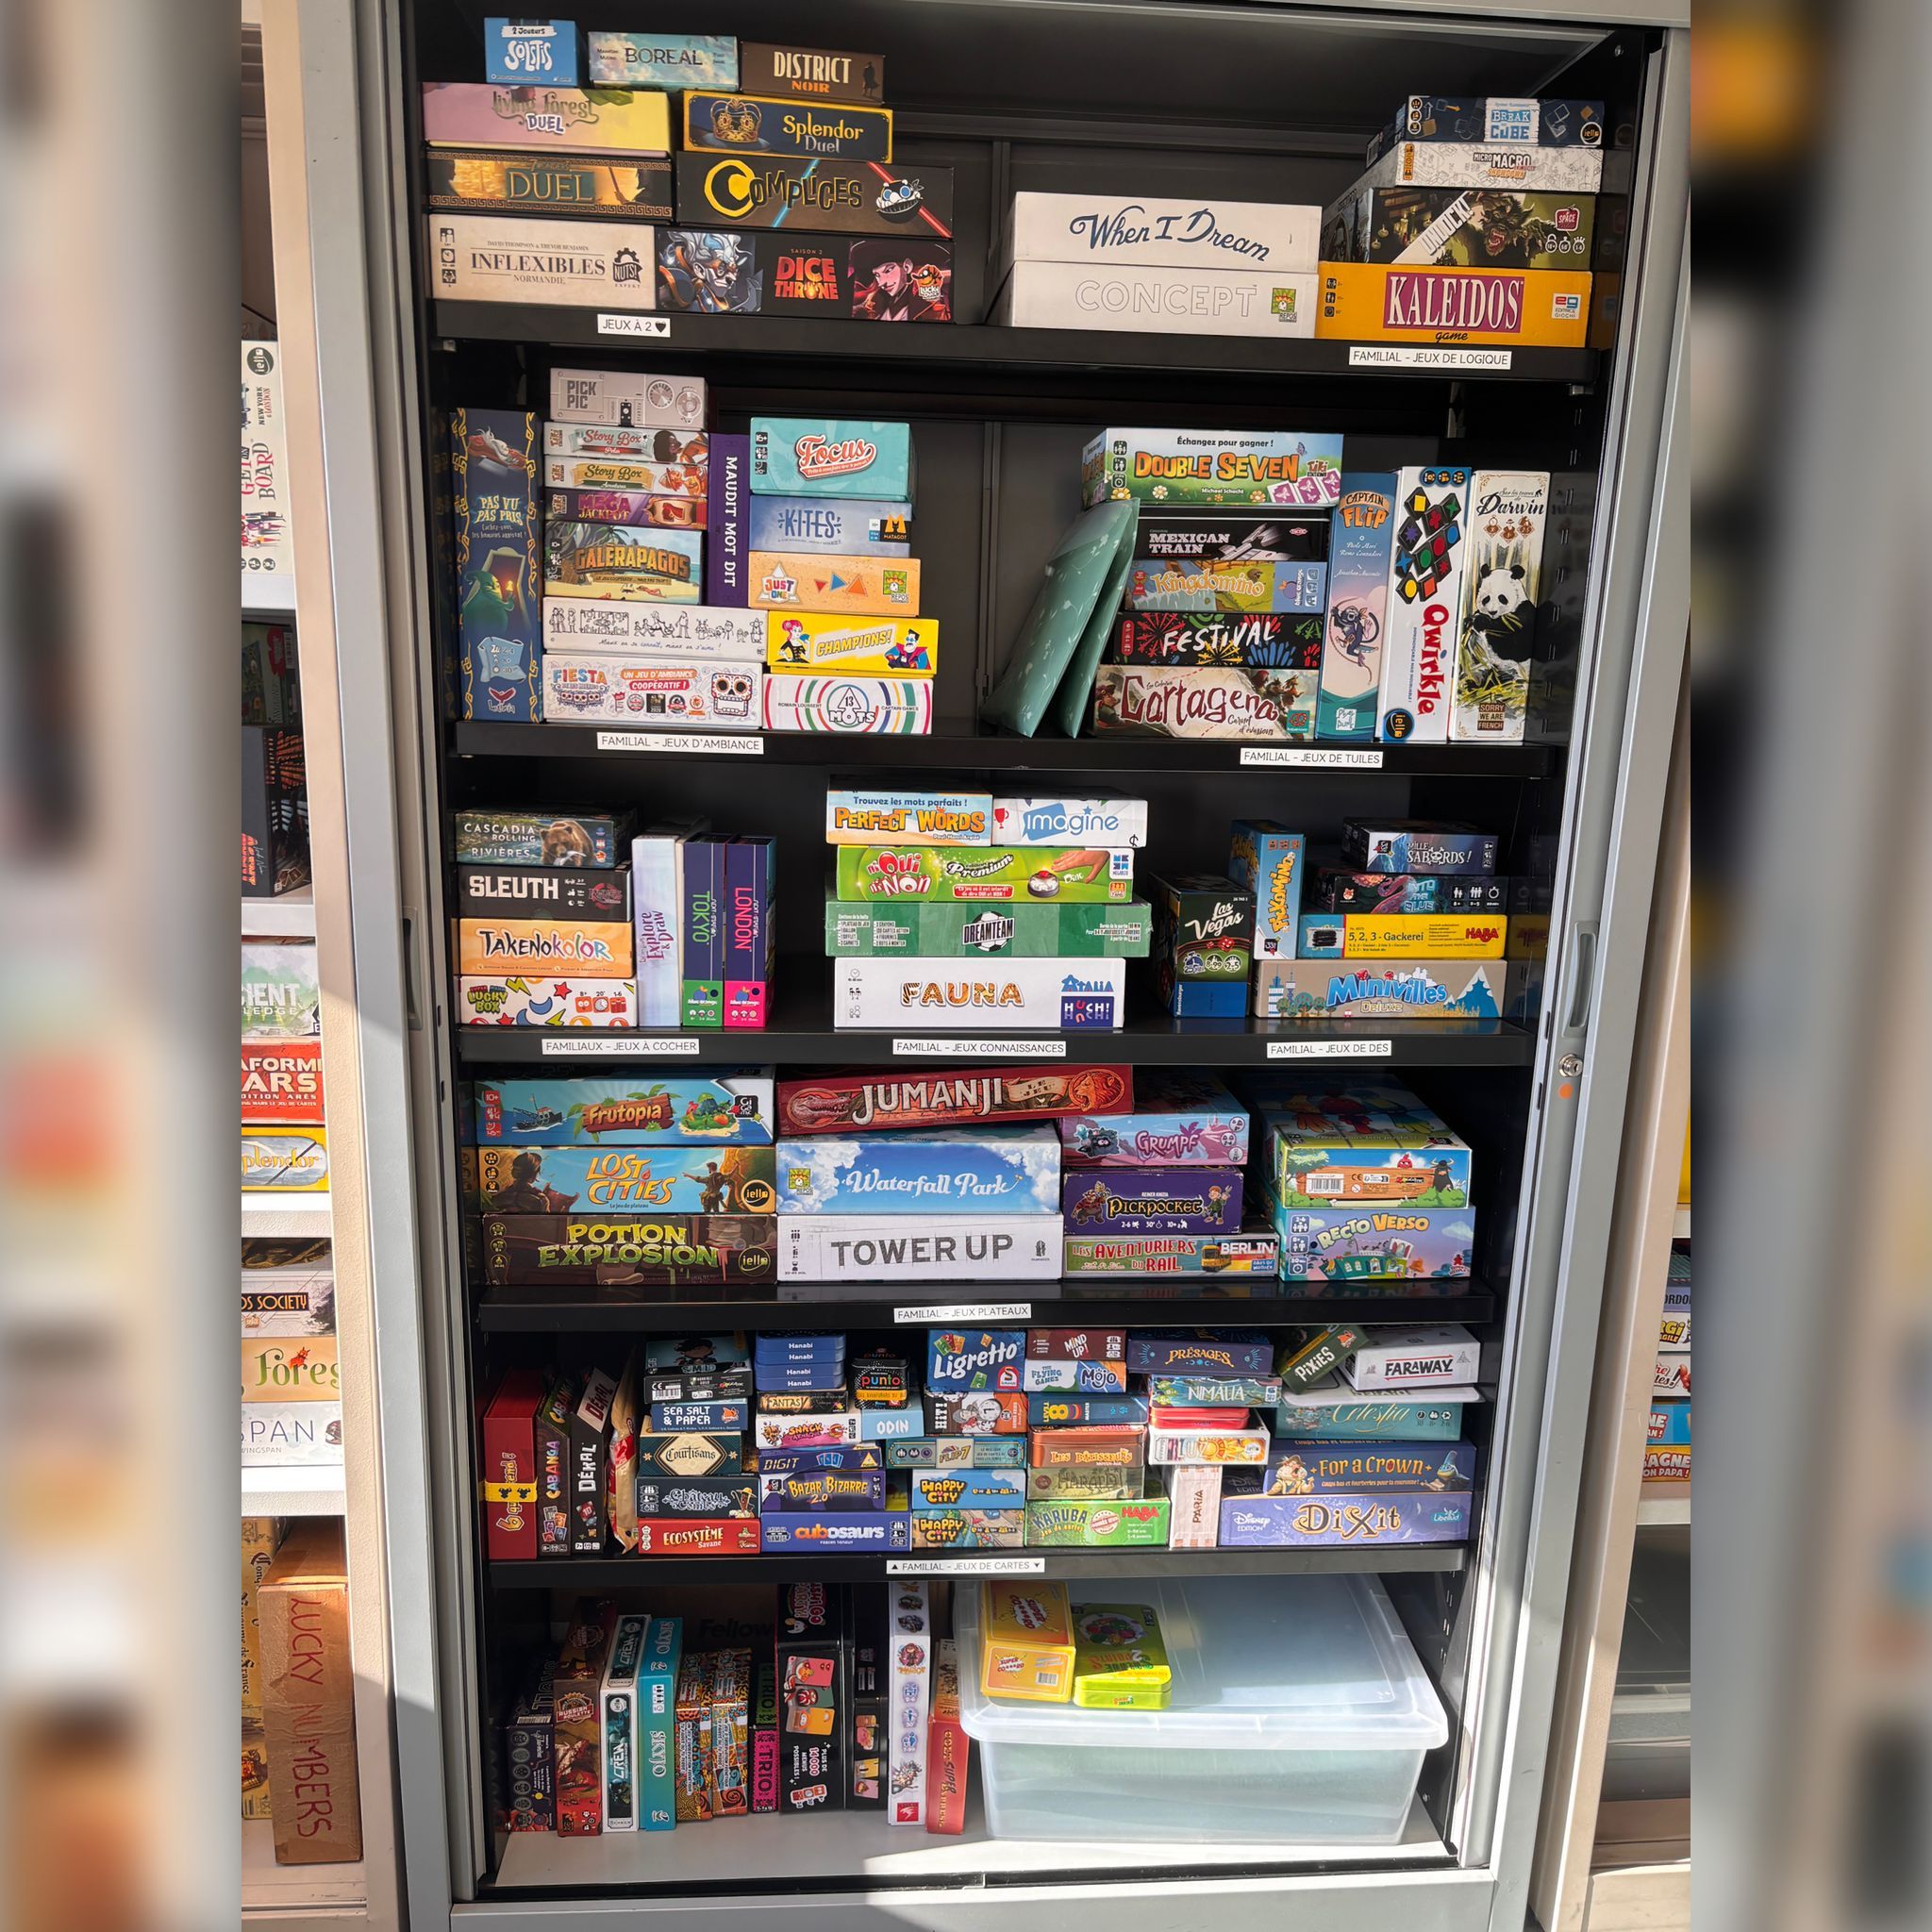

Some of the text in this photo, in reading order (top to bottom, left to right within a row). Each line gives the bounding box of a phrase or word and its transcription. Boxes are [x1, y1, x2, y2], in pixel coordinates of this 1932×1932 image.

[774, 51, 852, 84] DISTRICT
[791, 80, 830, 93] NOIR
[527, 115, 565, 134] DUEL
[782, 112, 864, 144] Splendor
[805, 135, 840, 154] Duel
[1491, 153, 1531, 168] MACRO
[508, 171, 592, 202] DUEL
[1070, 205, 1271, 262] When I Dream
[471, 252, 606, 276] INFLEXIBLES
[775, 256, 836, 283] DICE
[513, 274, 566, 285] NORMANDIE
[1074, 279, 1257, 318] CONCEPT
[1387, 275, 1522, 330] KALEIDOS
[602, 317, 652, 332] JEUX À 2
[1435, 331, 1469, 343] game
[1353, 350, 1508, 366] FAMILIAL JEUX DE LOGIQUE
[566, 380, 597, 396] PICK
[566, 394, 589, 409] PIC
[257, 408, 265, 425] NEW
[584, 429, 642, 445] Story Box
[1176, 435, 1269, 449] Échangez pour gagner
[796, 434, 875, 470] Focus
[252, 441, 276, 502] BOARD
[584, 464, 642, 479] Story Box
[1134, 451, 1300, 482] DOUBLE SEVEN
[1345, 491, 1384, 506] CAPTAIN
[1476, 492, 1545, 517] Darwin
[723, 456, 739, 587] MAUDIT MOT DIT
[1148, 533, 1230, 544] MEXICAN
[1148, 543, 1205, 555] TRAIN
[764, 577, 794, 591] JUST
[1150, 568, 1267, 597] Kingdomino
[1416, 604, 1450, 716] Qwirkle
[553, 668, 608, 685] FIESTA
[623, 670, 694, 679] UN JEU D'AMBIANCE
[631, 680, 682, 691] COOPÉRATIF
[844, 696, 854, 708] 13
[1479, 704, 1505, 712] SORRY
[1490, 712, 1504, 721] ARE
[601, 735, 760, 750] FAMILIAL JEUX D'AMBIANCE
[1243, 751, 1380, 765] FAMILIAL JEUX DE TUILES
[853, 795, 962, 808] Trouvez les mots parfaits
[834, 807, 985, 833] PERFECT WORDS
[464, 823, 536, 835] CASCADIA
[491, 834, 537, 842] ROLLING
[469, 874, 559, 900] SLEUTH
[691, 891, 710, 942] TOKYO
[734, 887, 753, 951] LONDON
[1212, 902, 1234, 922] Las
[963, 921, 1015, 943] DREAMTEAM
[1185, 911, 1244, 941] Vegas
[1465, 926, 1499, 942] HABA
[1383, 932, 1424, 942] Gackerei
[901, 980, 1025, 1008] FAUNA
[545, 1039, 697, 1052] FAMILIAUX JEUX À COCHER
[896, 1041, 1064, 1054] FAMILIAL JEUX CONNAISSANCES
[1271, 1044, 1316, 1055] FAMILIAL
[1325, 1043, 1351, 1054] JEUX
[1353, 1043, 1367, 1053] DE
[851, 1076, 1004, 1126] JUMANJI
[588, 1103, 662, 1127] Frutopia
[586, 1153, 653, 1181] LOST
[587, 1176, 677, 1205] CITIES
[841, 1168, 1010, 1199] Waterfall Park
[567, 1223, 687, 1245] POTION
[1317, 1213, 1430, 1250] RECTO VERSO
[537, 1243, 720, 1268] EXPLOSION
[830, 1233, 1014, 1267] TOWER UP
[1094, 1239, 1197, 1259] AVENTURIERS
[1220, 1241, 1274, 1256] BERLIN
[1145, 1257, 1182, 1272] RAIL
[257, 1293, 307, 1310] SOCIETY
[897, 1307, 1028, 1320] FAMILIAL JEUX PLATEAUX
[933, 1342, 1019, 1380] Ligretto
[1384, 1357, 1454, 1377] FARAWAY
[861, 1374, 901, 1389] punto
[1034, 1376, 1059, 1386] GAMES
[663, 1406, 710, 1416] SEA SALT
[675, 1415, 711, 1425] PAPER
[875, 1420, 910, 1435] ODIN
[1319, 1456, 1424, 1477] For a Crown
[1660, 1467, 1684, 1478] PAPA
[1191, 1489, 1204, 1524] PARIA
[1232, 1510, 1272, 1525] Disney
[1433, 1512, 1460, 1523] Libellud
[902, 1561, 1030, 1571] FAMILIAL JEUX DE CARTES
[290, 1597, 334, 1839] LUCKY NUMBERS
[808, 1745, 821, 1777] 14000
[757, 1748, 774, 1793] TRIO
